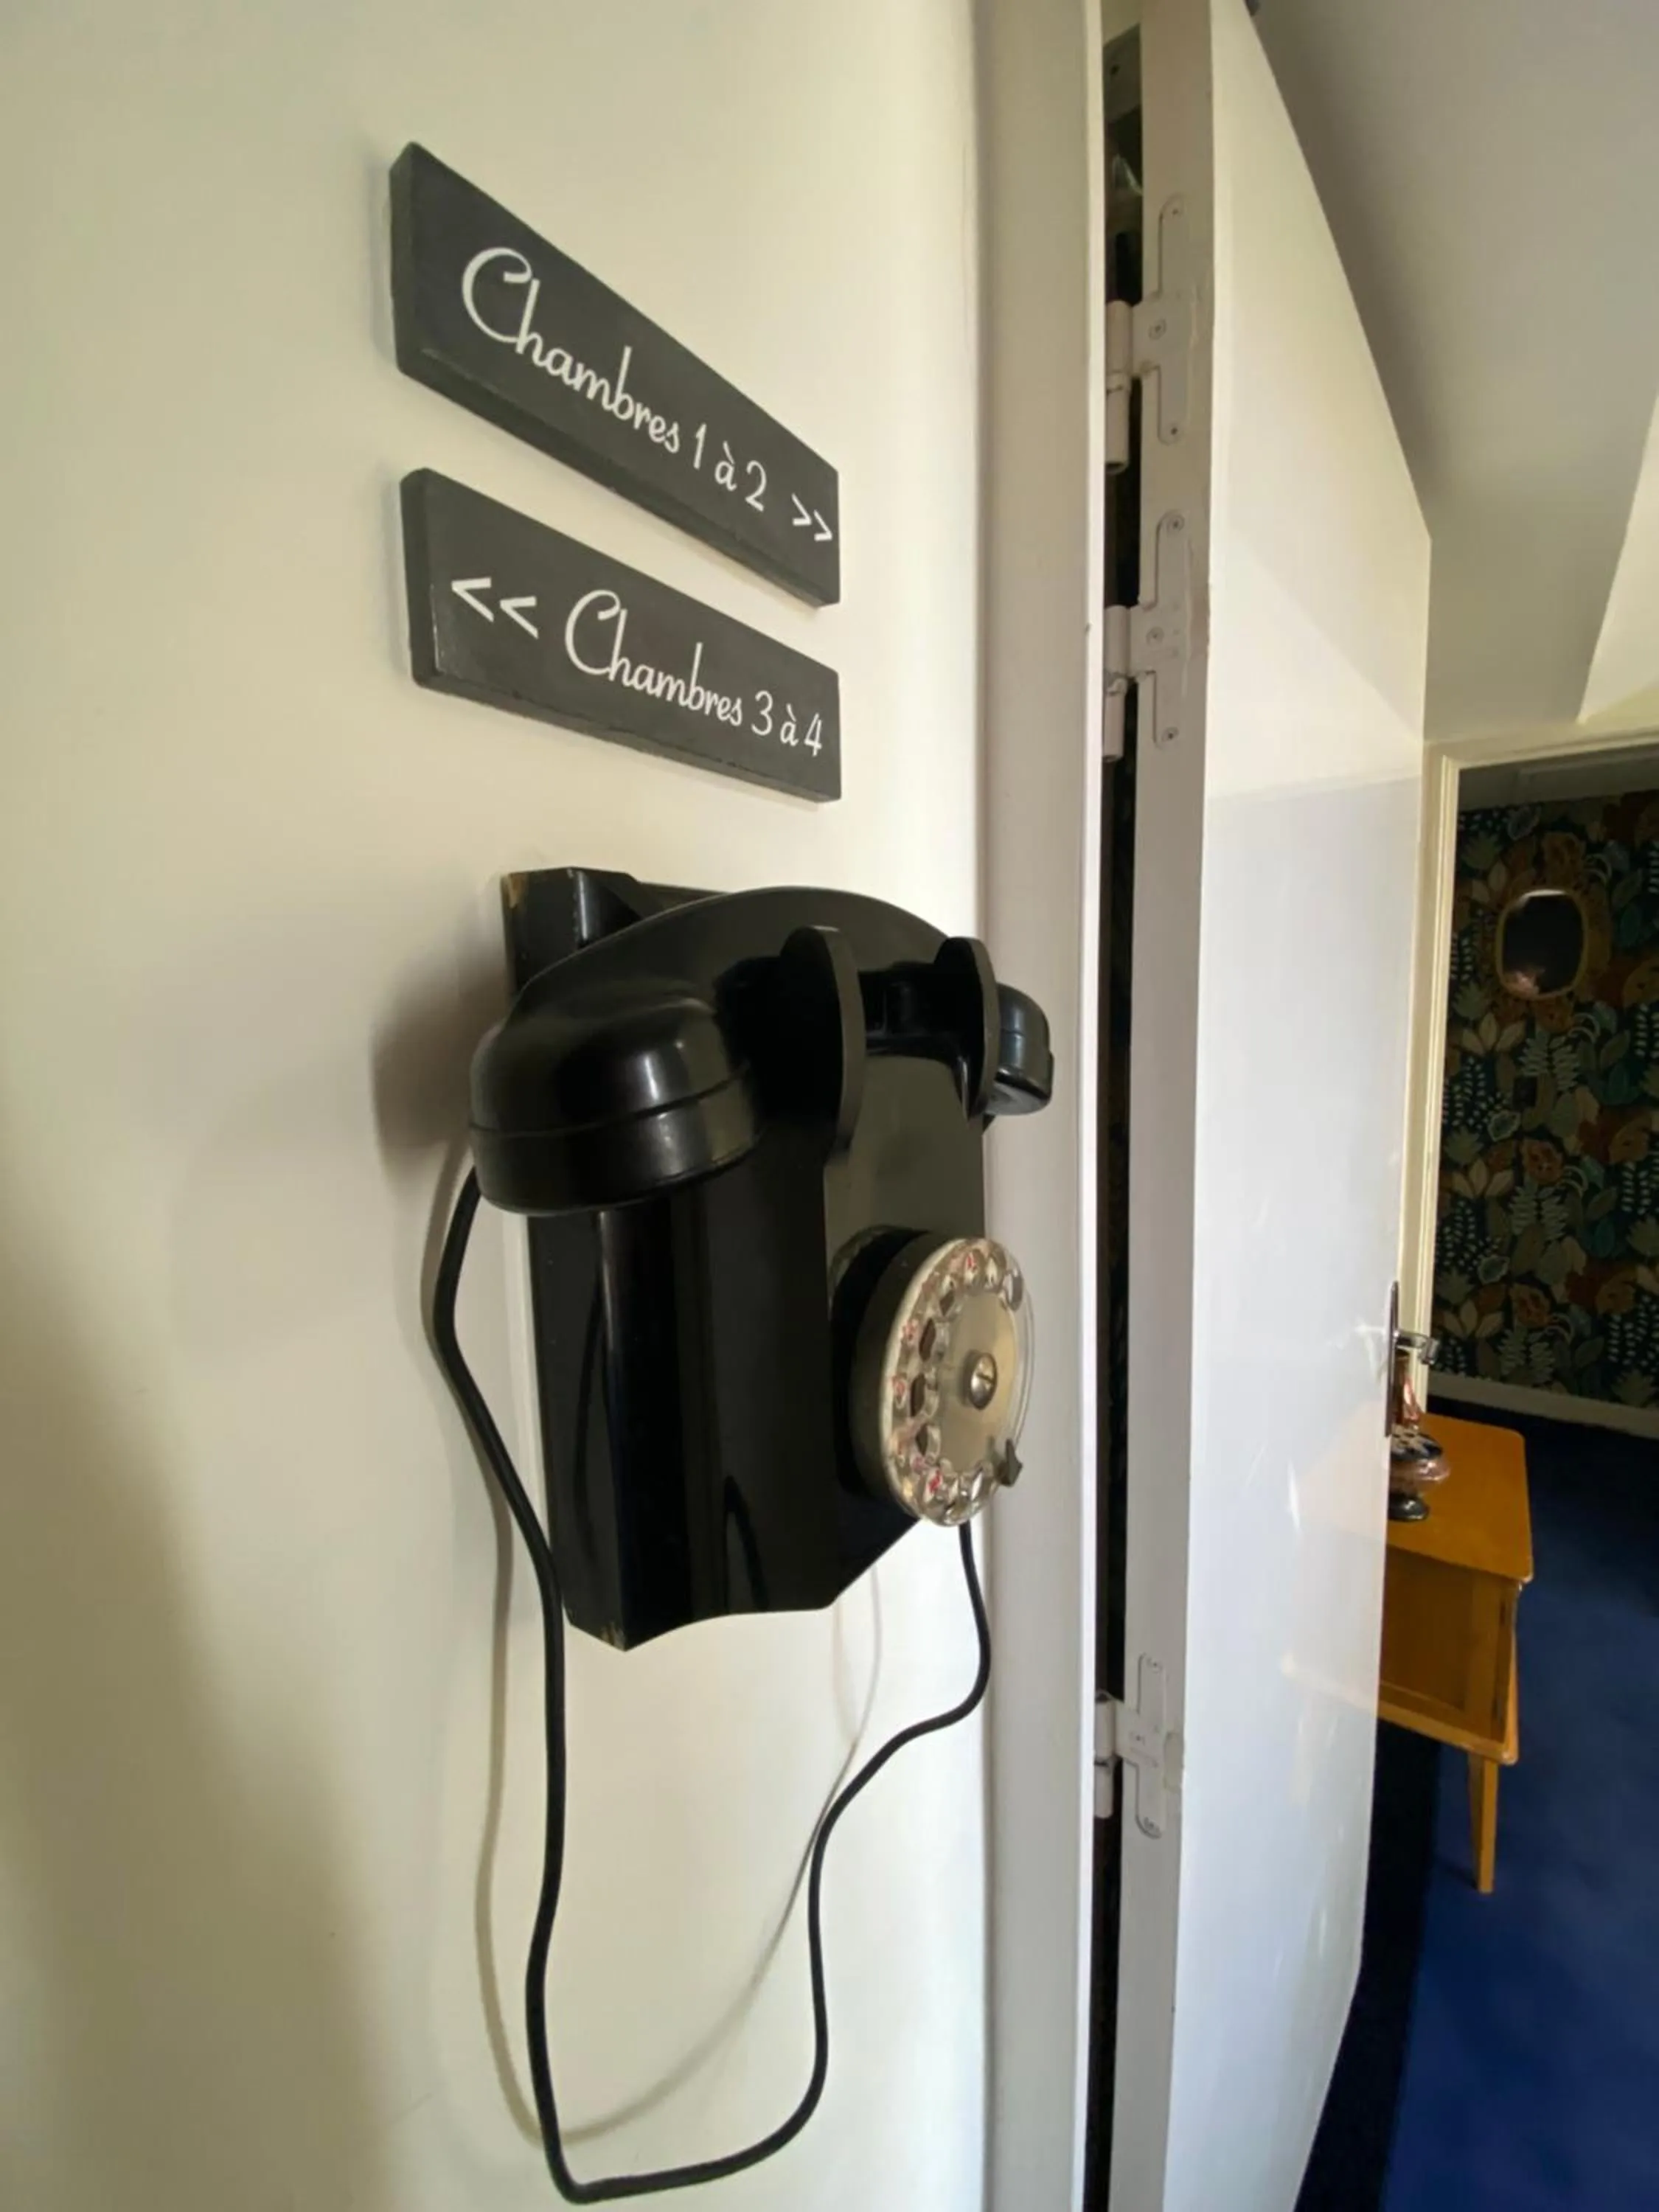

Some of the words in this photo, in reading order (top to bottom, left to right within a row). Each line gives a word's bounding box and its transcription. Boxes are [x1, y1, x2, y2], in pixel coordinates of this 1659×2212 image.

[462, 247, 681, 454] Chambres
[693, 422, 707, 470] 1
[714, 440, 738, 492] à
[744, 459, 768, 512] 2
[564, 588, 743, 727] Chambres
[751, 689, 773, 737] 3
[779, 703, 800, 748] à
[803, 712, 824, 758] 4
